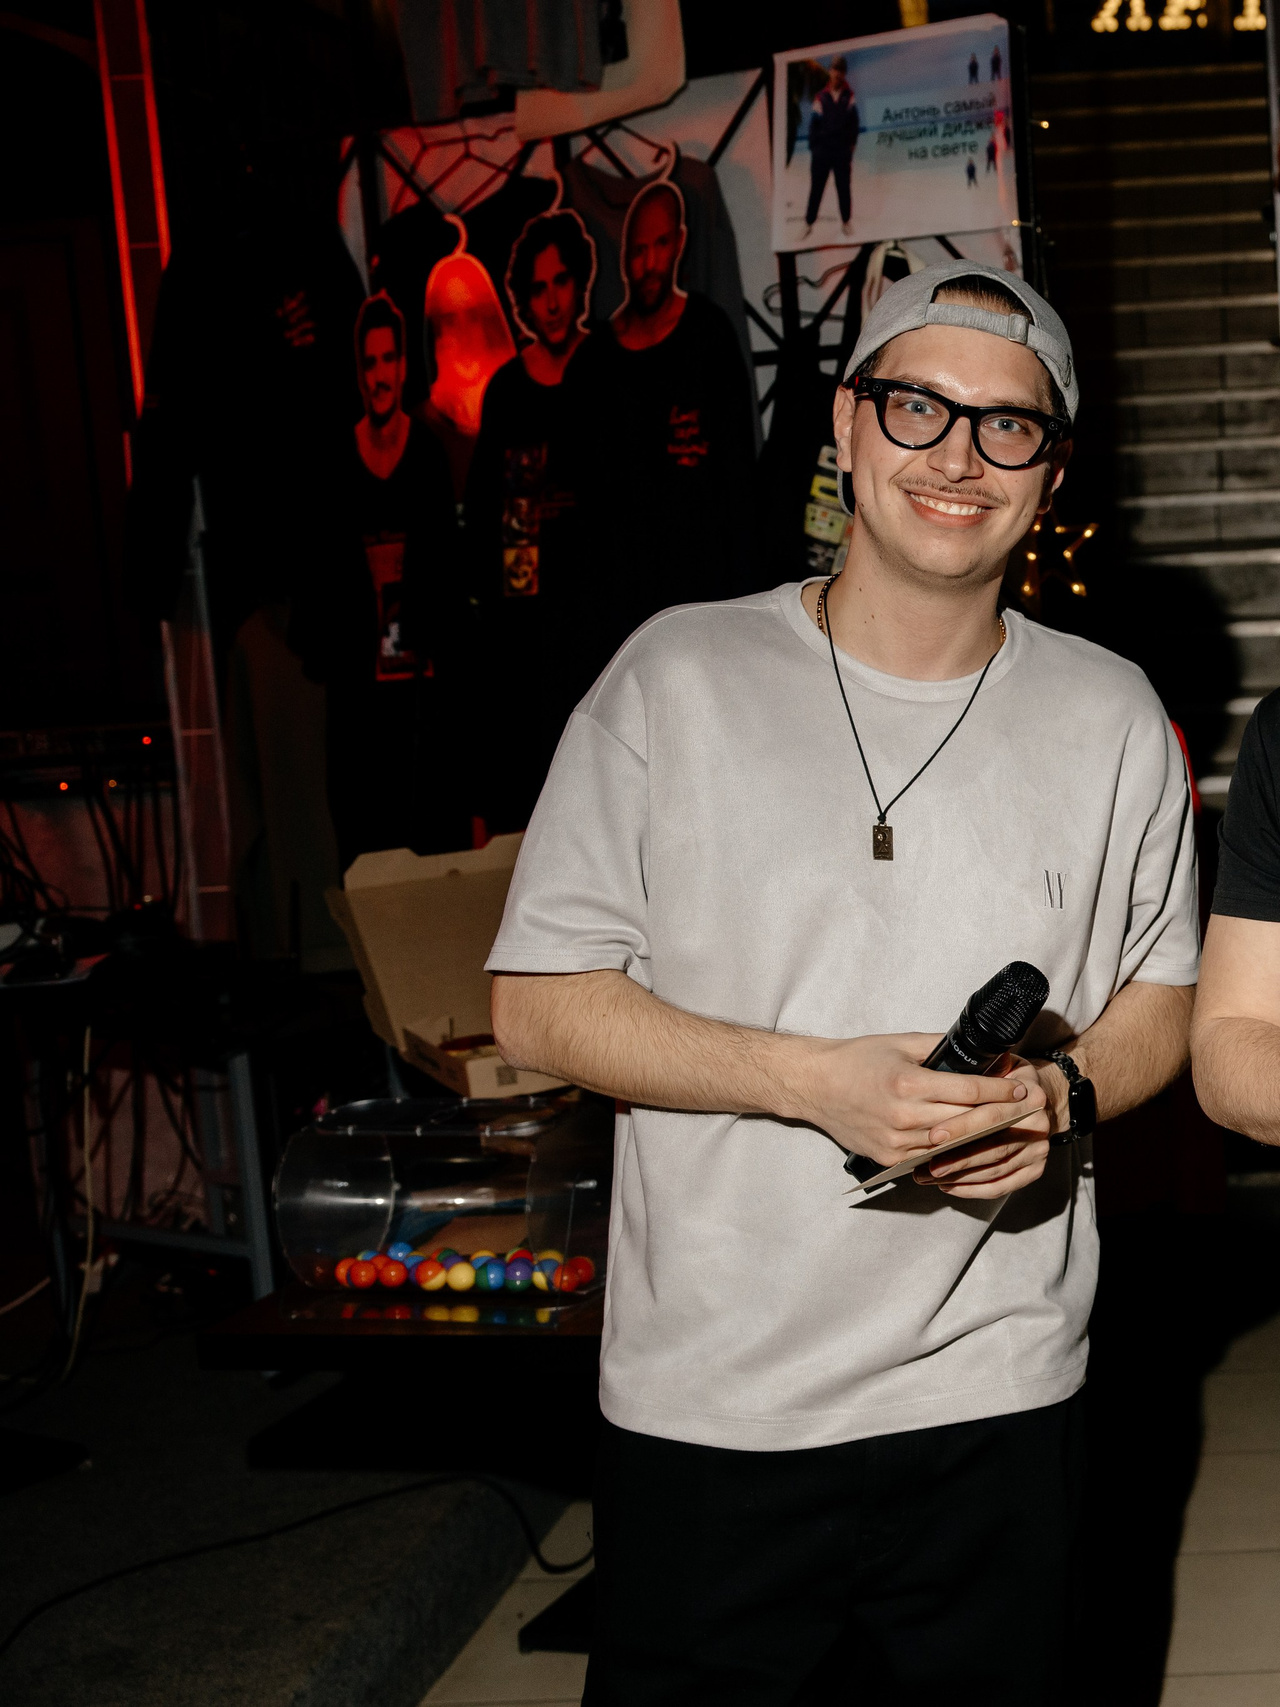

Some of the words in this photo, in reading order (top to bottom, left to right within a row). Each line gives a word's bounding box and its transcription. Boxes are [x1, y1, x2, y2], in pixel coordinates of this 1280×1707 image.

[876, 121, 938, 148] лучший
[908, 146, 928, 160] на
[931, 140, 979, 159] свете
